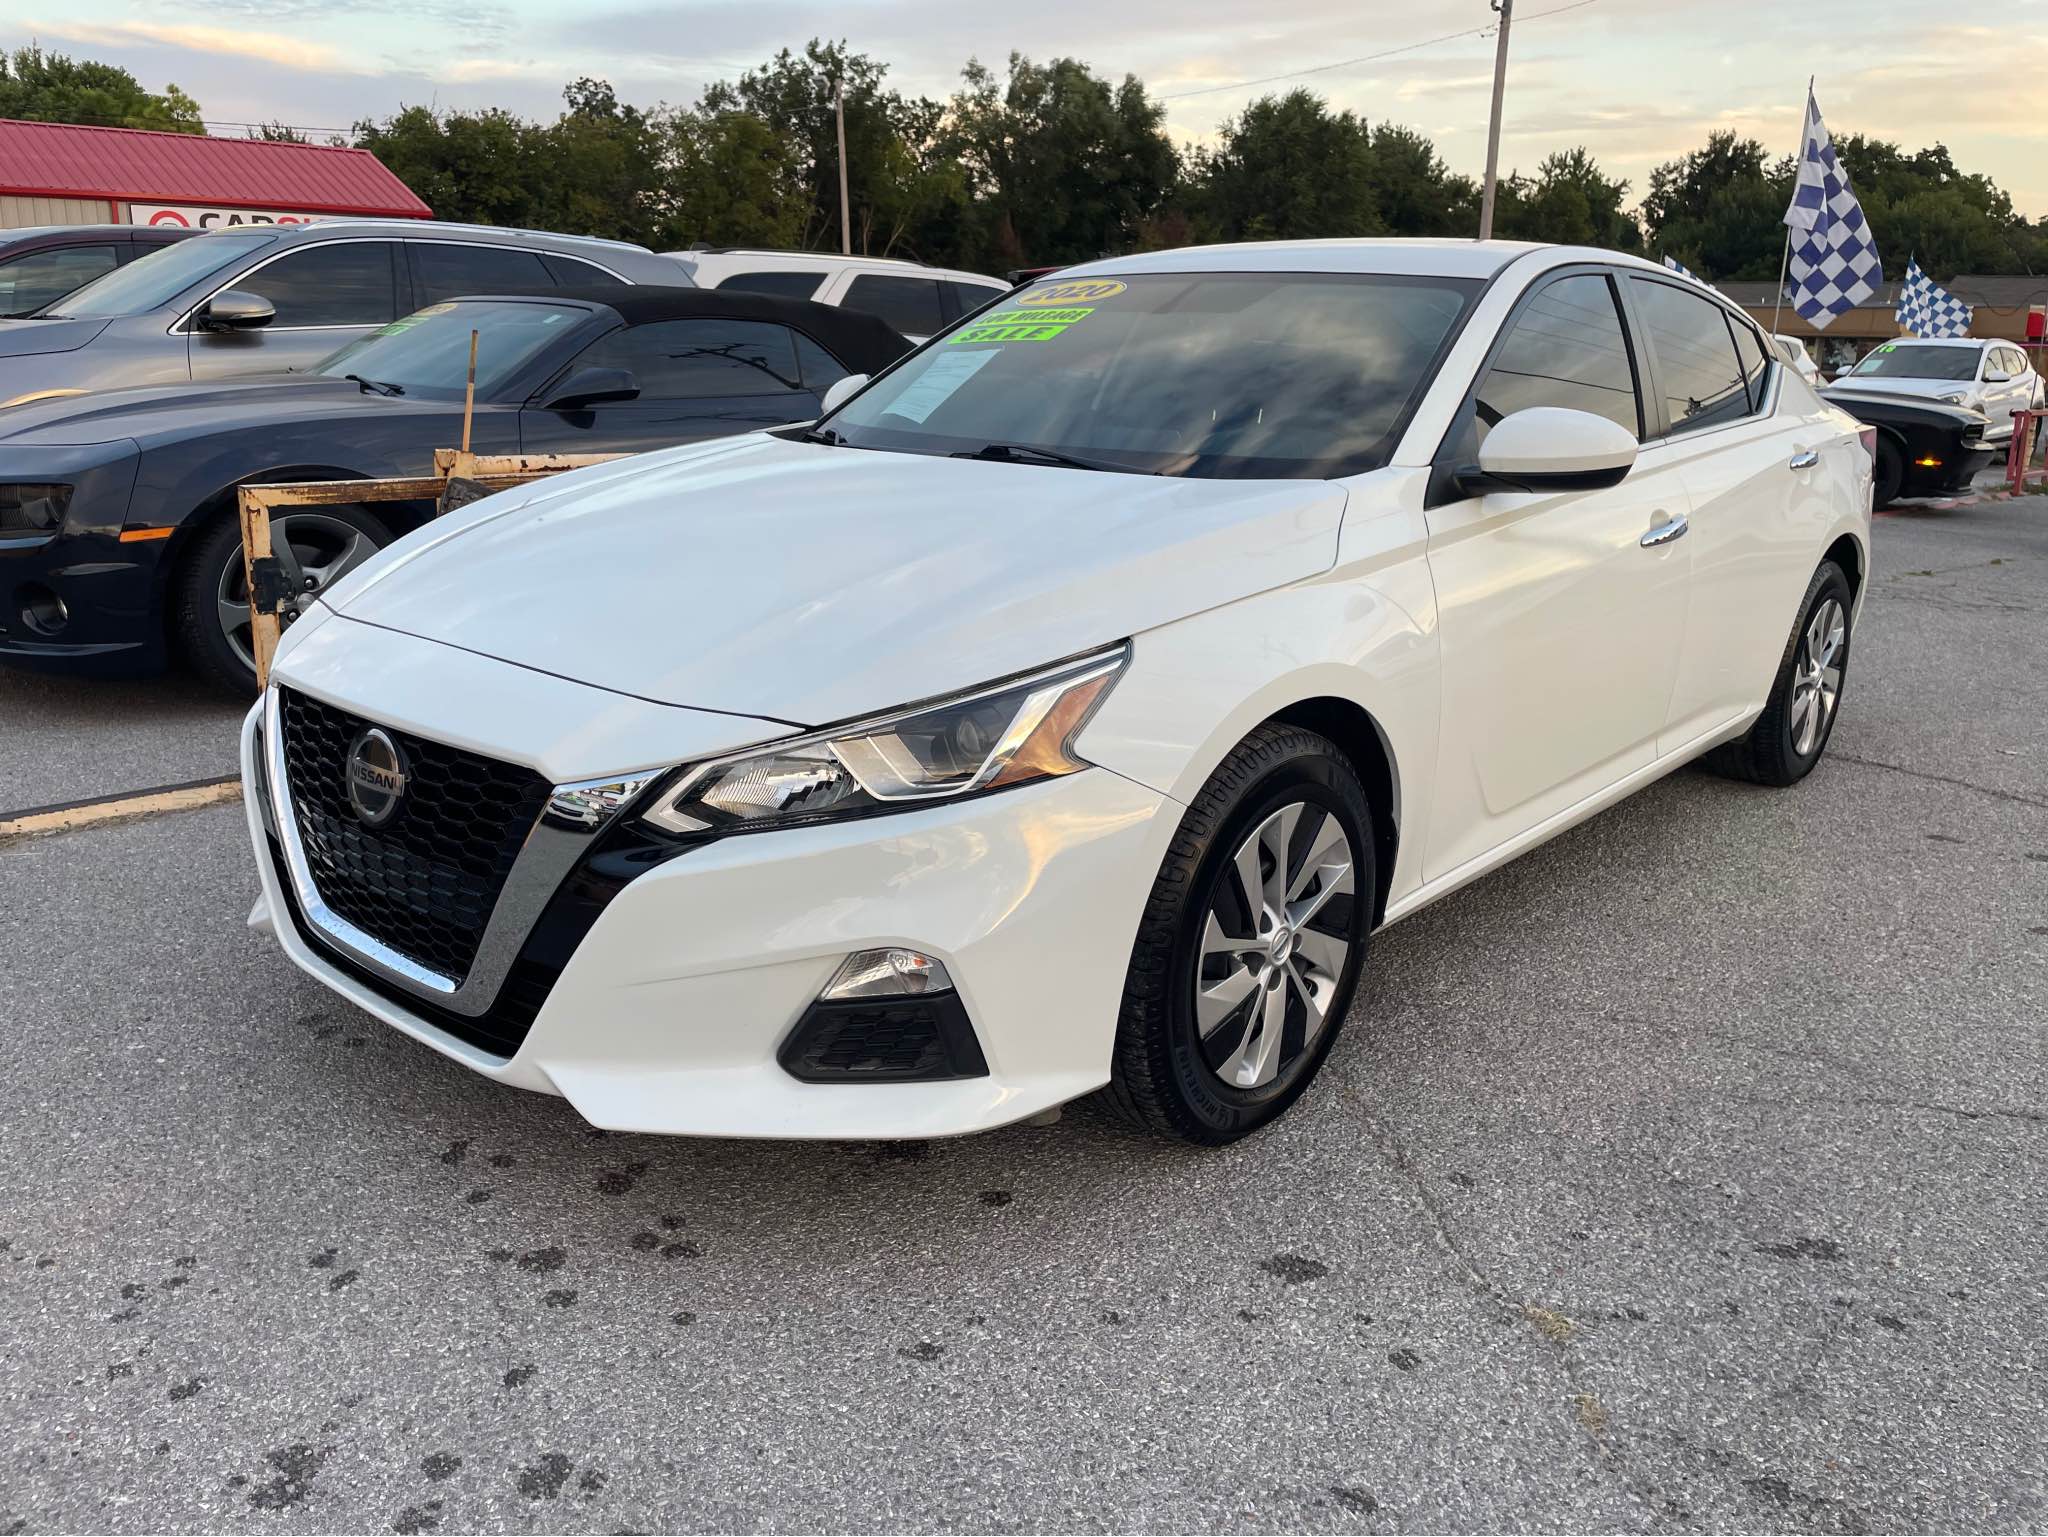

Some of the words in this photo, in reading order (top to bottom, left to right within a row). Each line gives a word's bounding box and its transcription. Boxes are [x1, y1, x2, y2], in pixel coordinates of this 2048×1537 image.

[1023, 284, 1116, 302] 2020
[1012, 310, 1087, 322] MILEAGE
[960, 326, 1053, 341] SALE
[352, 761, 394, 790] NISSAN
[1178, 1048, 1220, 1117] MICHELIN
